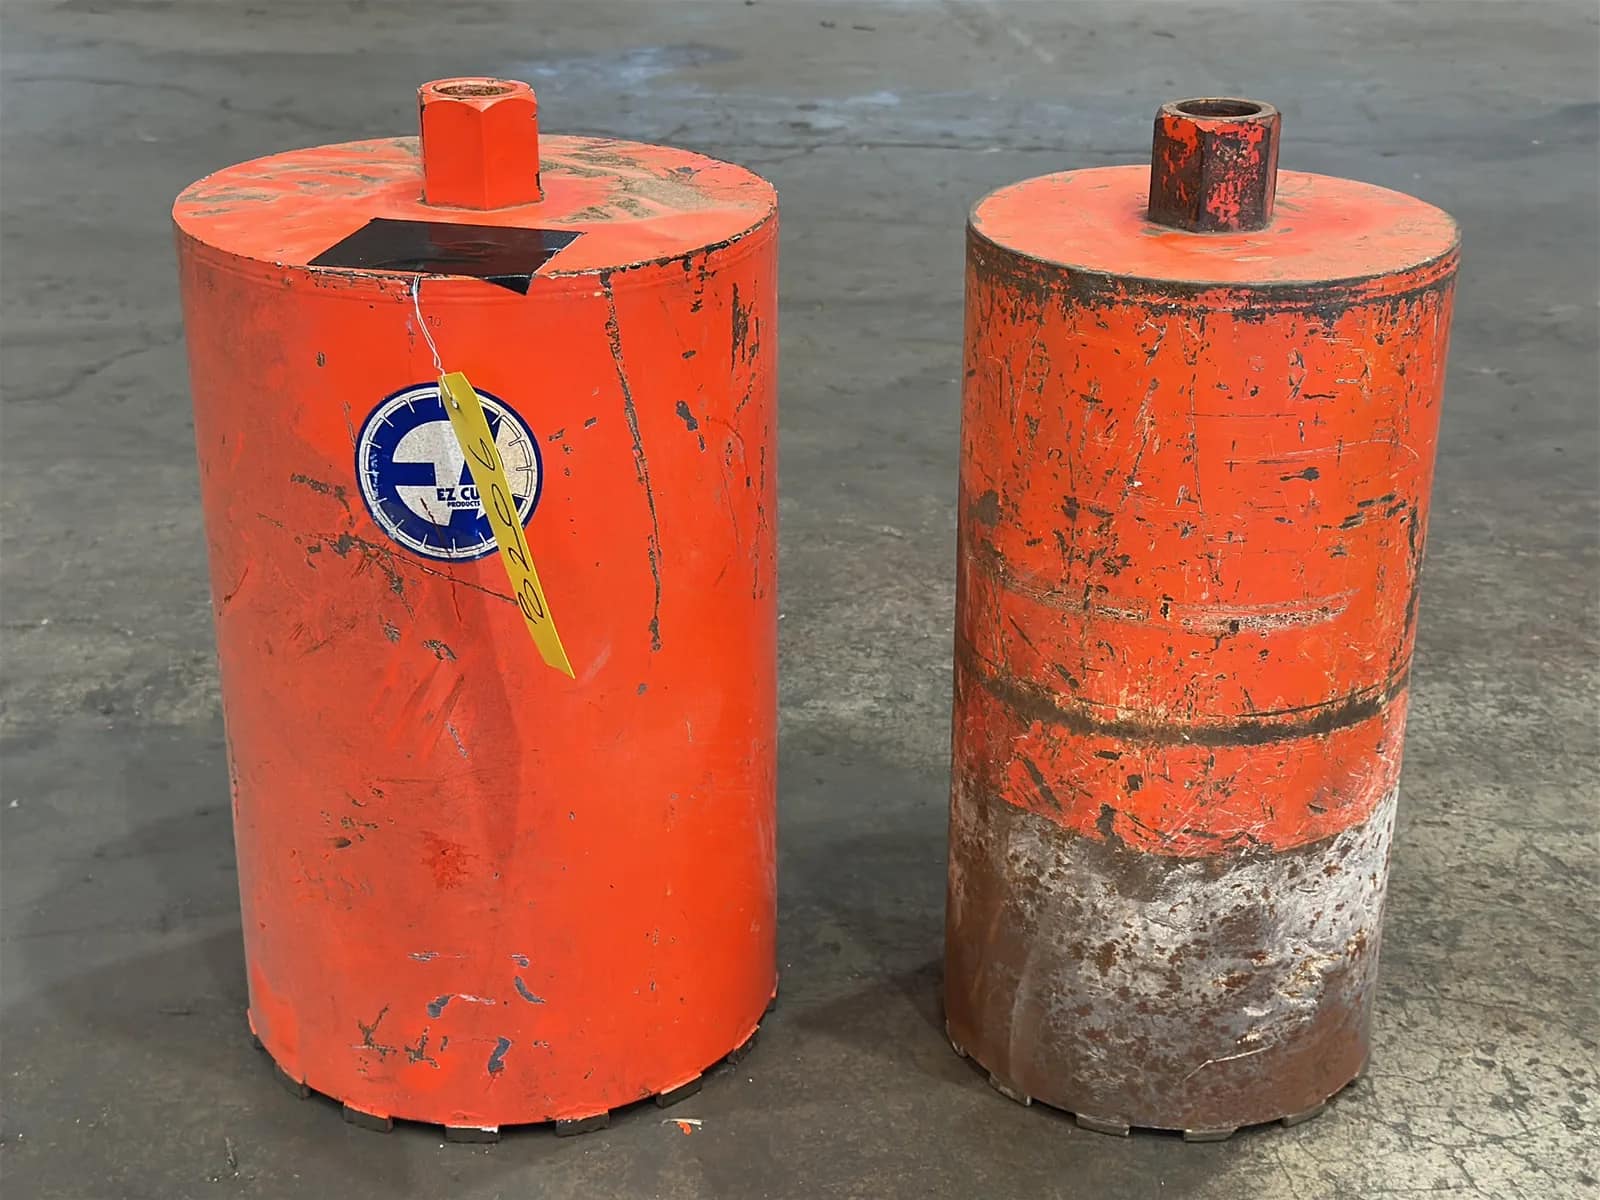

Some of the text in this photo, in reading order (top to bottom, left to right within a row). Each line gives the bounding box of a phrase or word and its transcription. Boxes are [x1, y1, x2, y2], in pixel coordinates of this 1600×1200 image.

[436, 487, 481, 501] EZ CU
[447, 500, 481, 508] PRODUCTS
